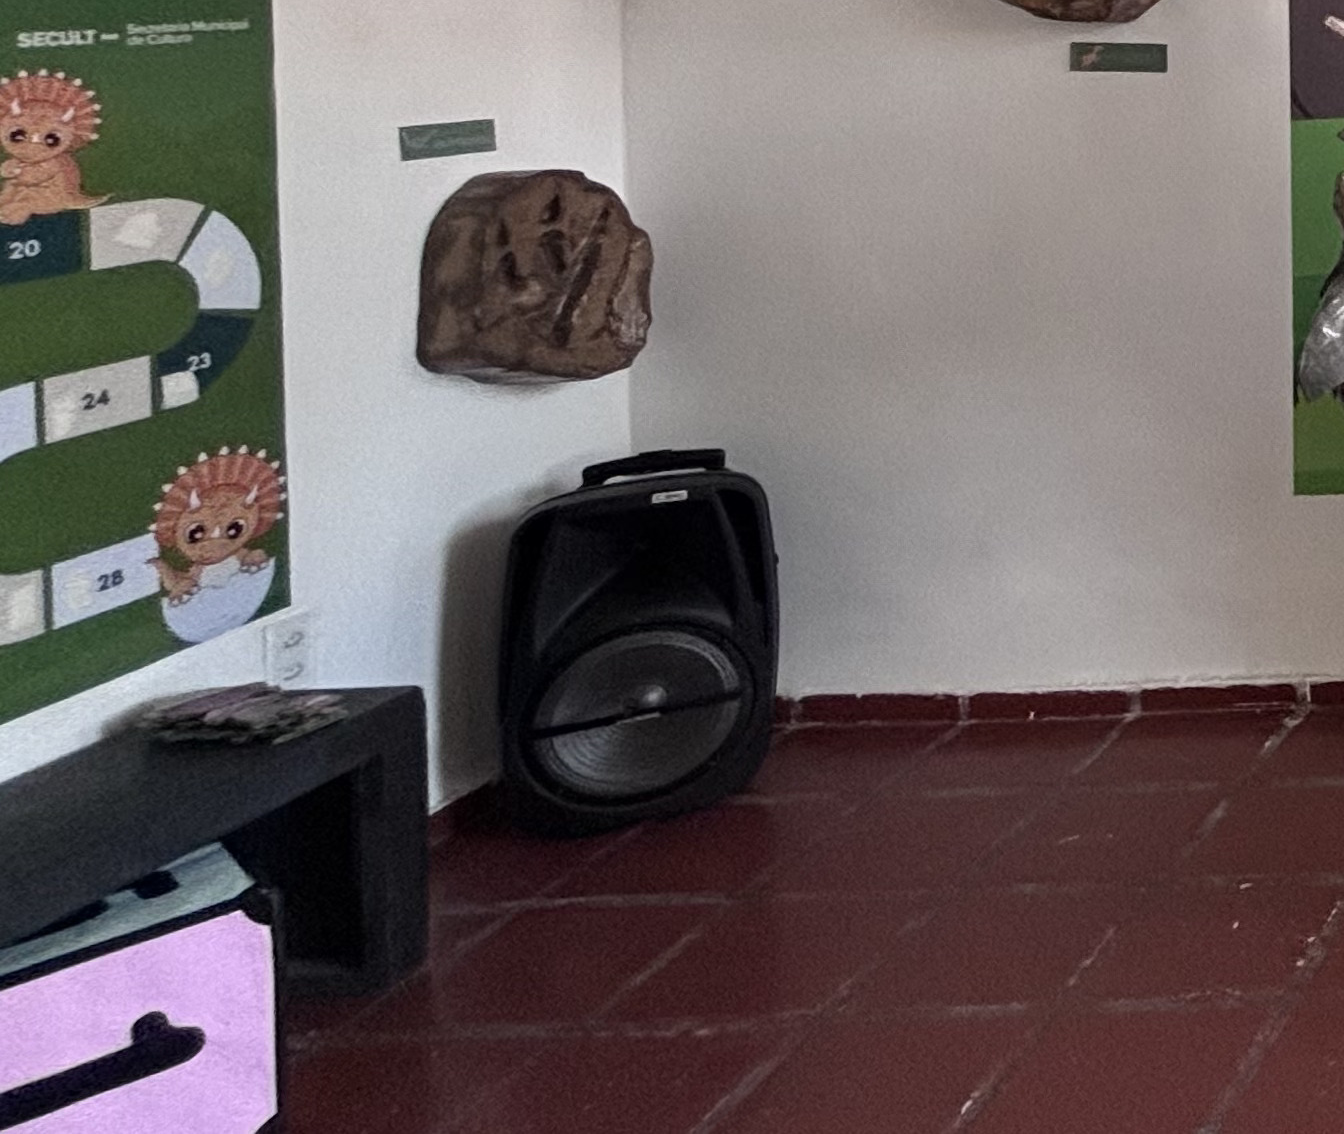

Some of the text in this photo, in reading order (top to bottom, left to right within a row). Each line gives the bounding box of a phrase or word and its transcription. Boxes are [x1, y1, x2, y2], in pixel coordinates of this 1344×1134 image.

[16, 29, 97, 48] SECULT
[8, 239, 41, 260] 20
[187, 352, 212, 372] 23
[81, 389, 110, 411] 24
[97, 569, 125, 593] 28
